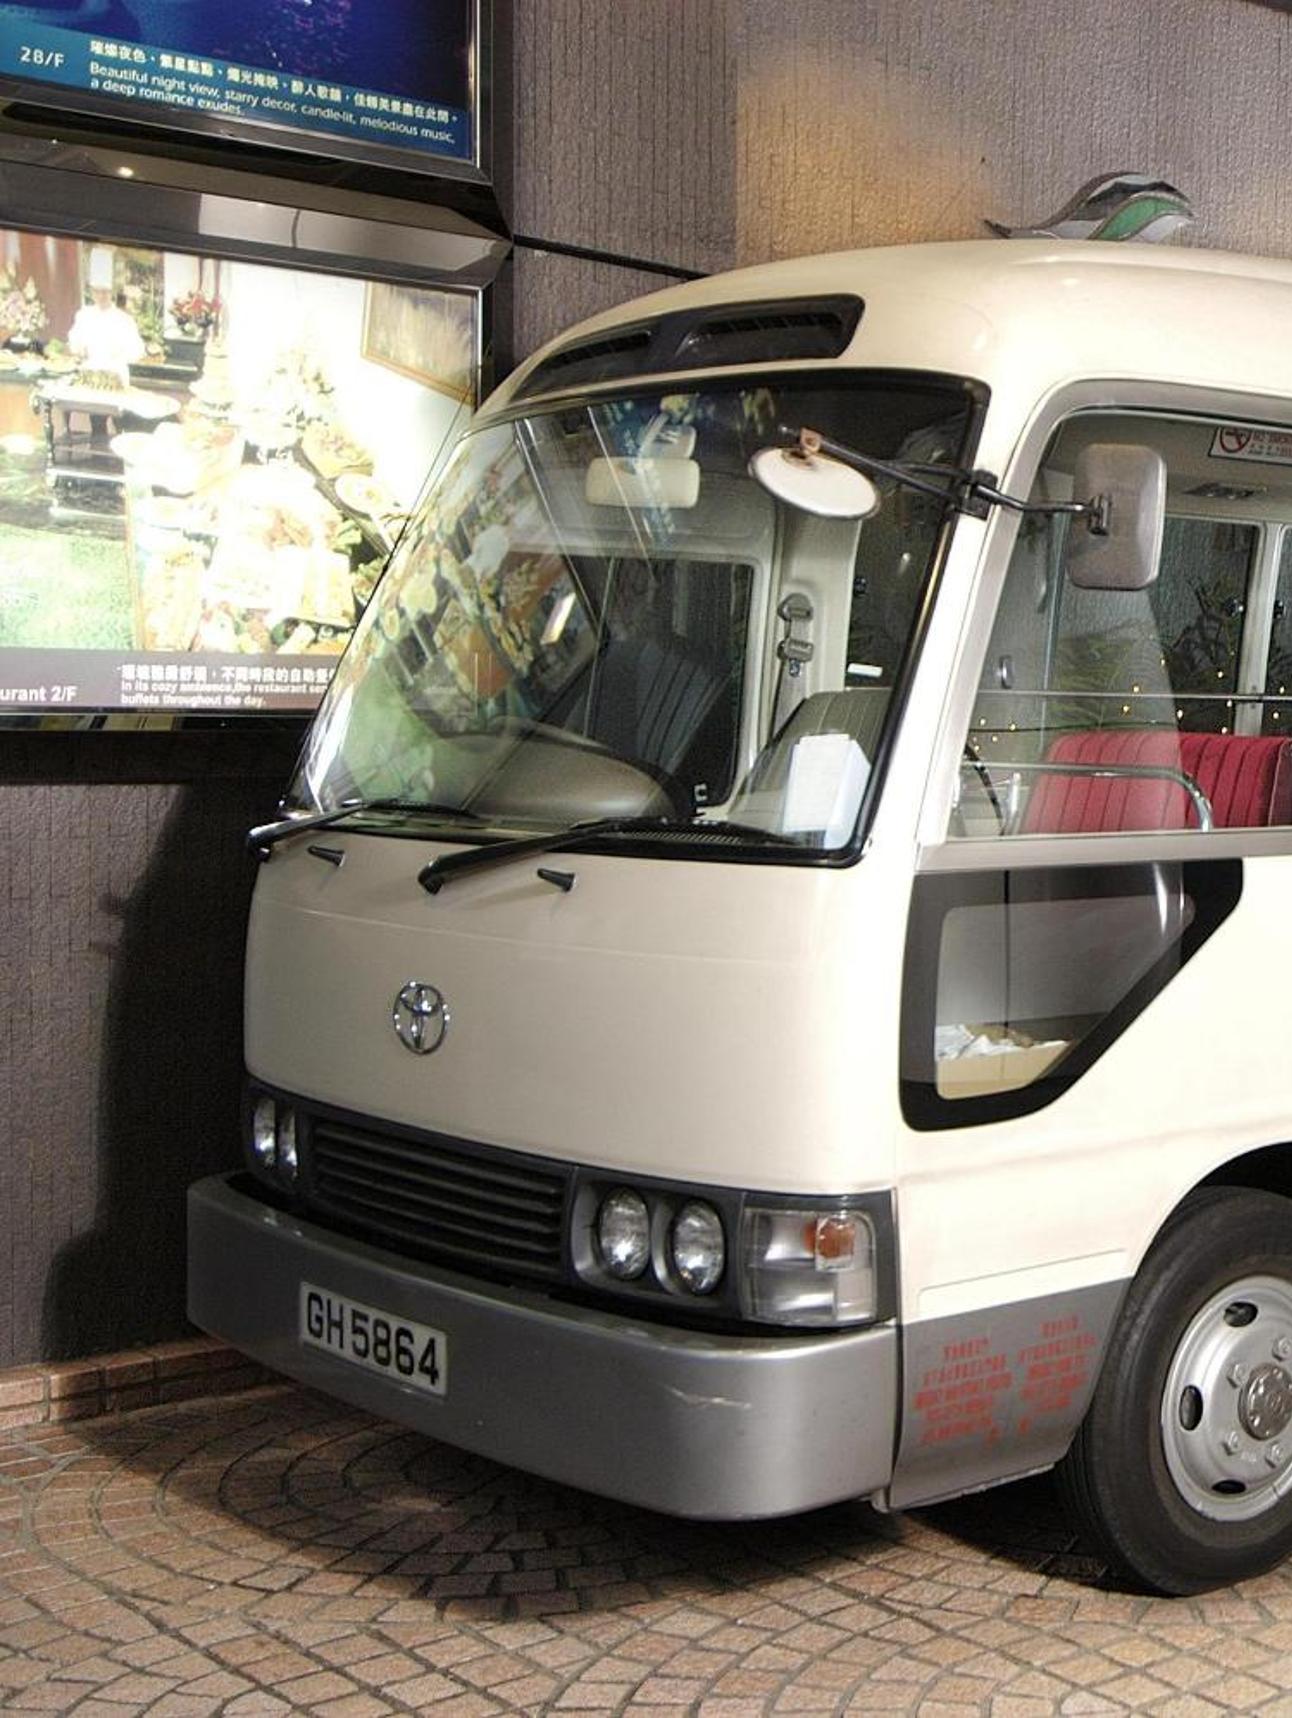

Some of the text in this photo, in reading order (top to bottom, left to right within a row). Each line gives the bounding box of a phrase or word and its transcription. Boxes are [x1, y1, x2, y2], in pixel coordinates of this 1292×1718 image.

[20, 45, 65, 68] 28/F
[89, 60, 149, 83] Beautiful
[151, 74, 186, 92] night
[188, 81, 221, 100] view,
[225, 90, 260, 108] starry
[359, 115, 419, 136] melodious
[90, 78, 99, 88] a
[102, 80, 136, 97] deep
[139, 87, 195, 107] romance
[50, 684, 78, 702] 2/F
[151, 682, 178, 695] cozy
[121, 692, 160, 705] buffets
[223, 694, 242, 706] the
